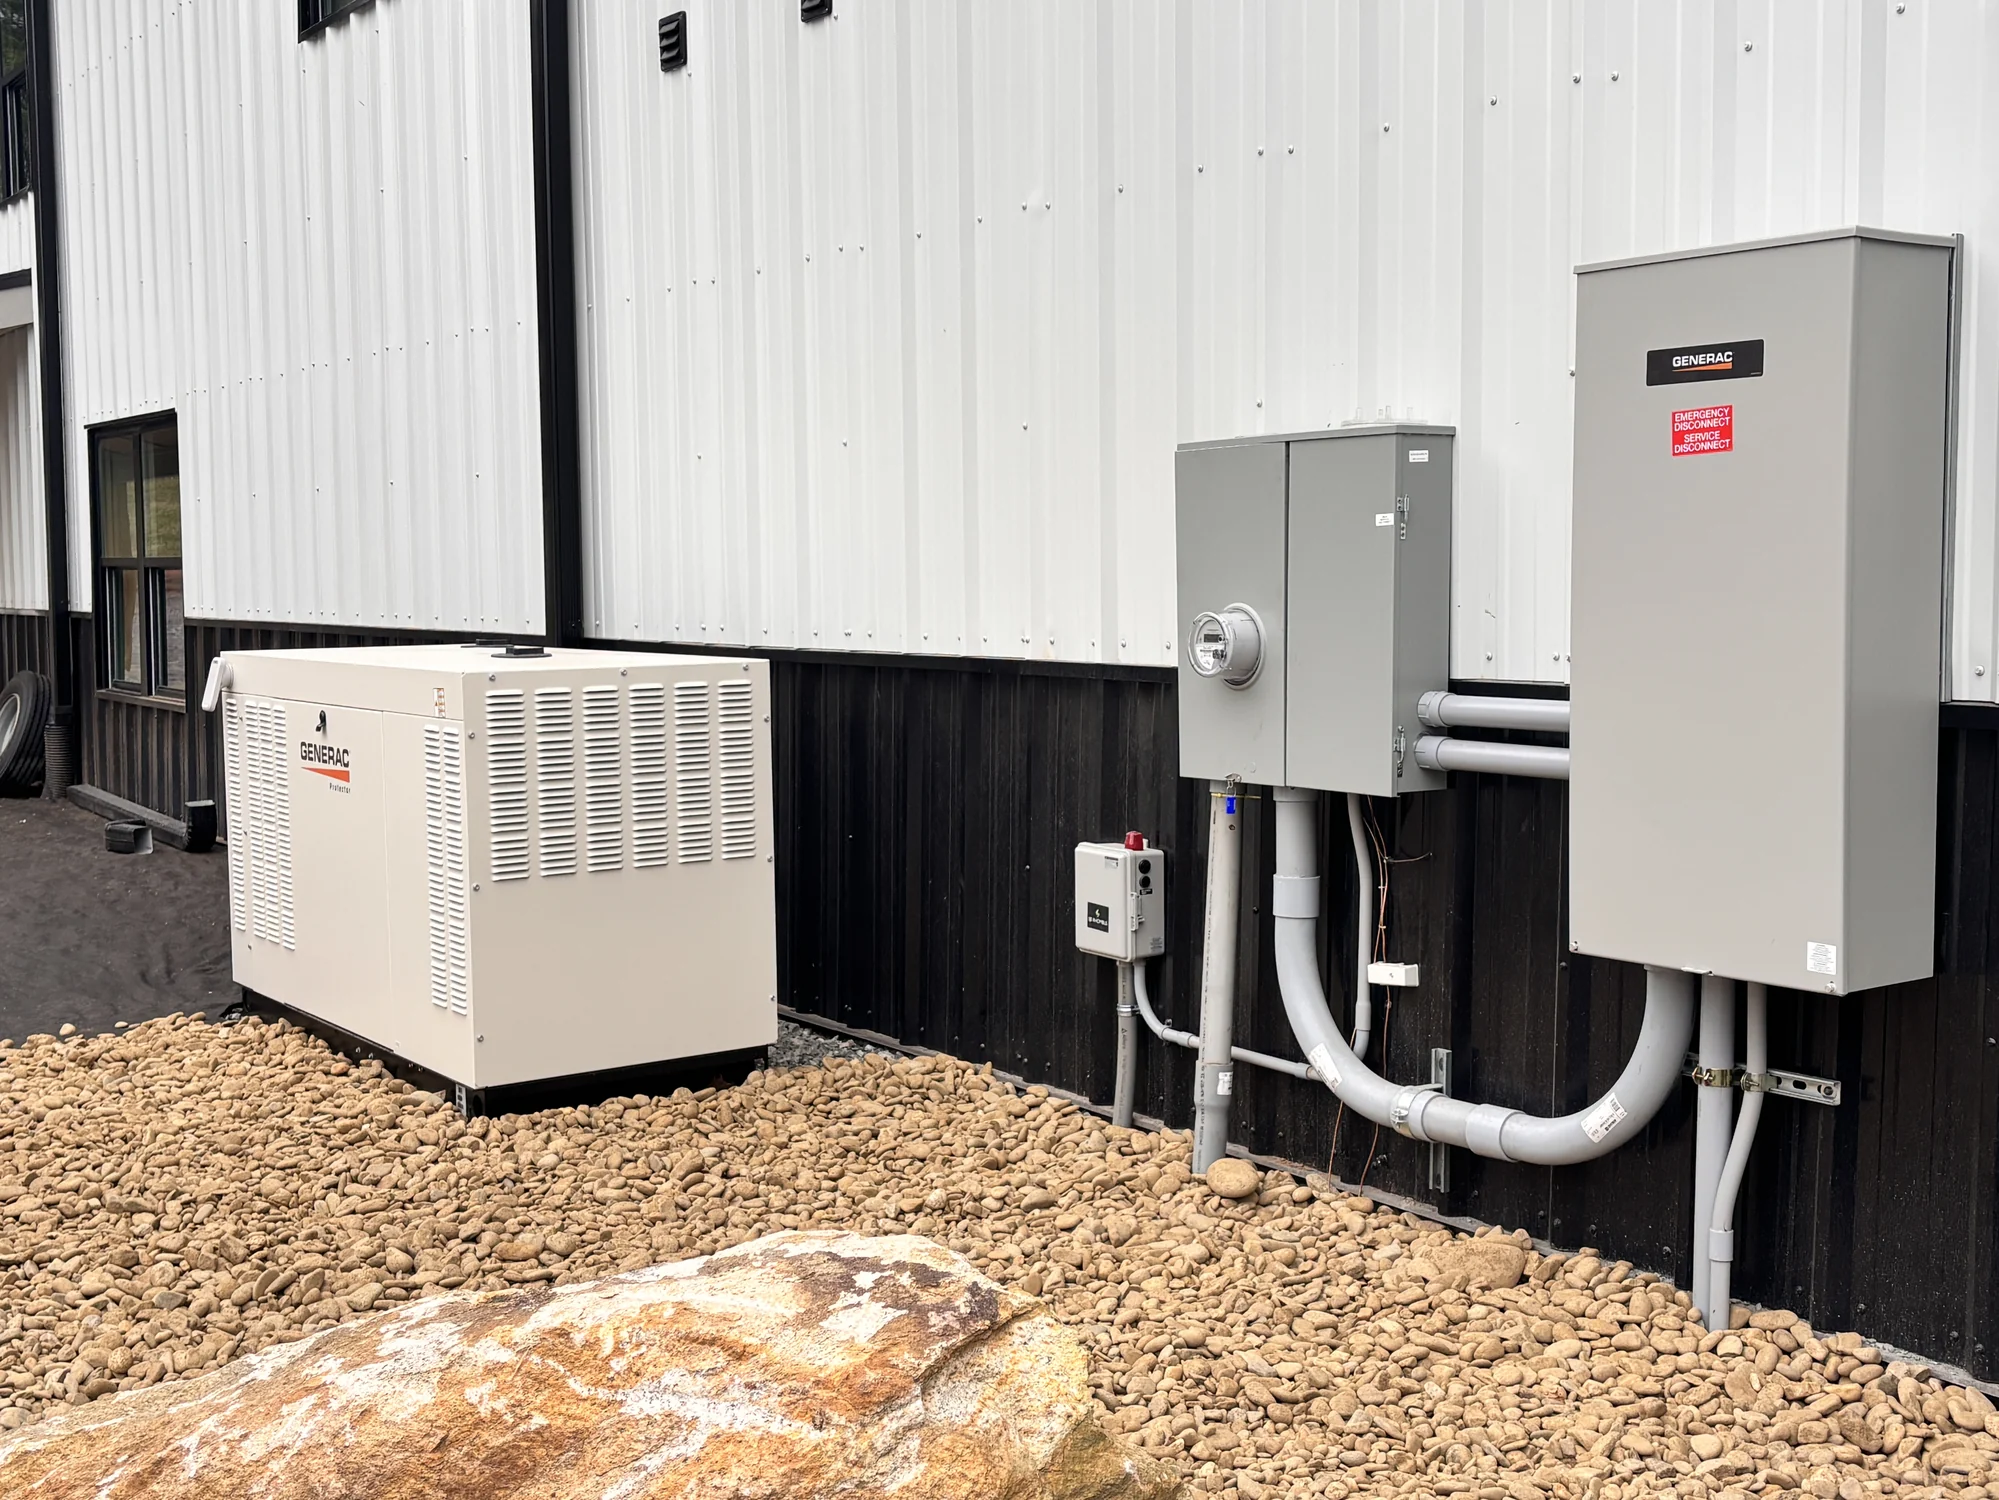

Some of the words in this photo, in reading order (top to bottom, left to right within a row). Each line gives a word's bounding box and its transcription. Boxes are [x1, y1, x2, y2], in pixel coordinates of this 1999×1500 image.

[1672, 351, 1733, 367] GENERAC
[1674, 408, 1729, 422] EMERGENCY
[1674, 417, 1731, 431] DISCONNECT
[1684, 431, 1720, 443] SERVICE
[1674, 439, 1731, 453] DISCONNECT
[300, 741, 350, 768] GENERAC
[329, 783, 350, 794] Protector
